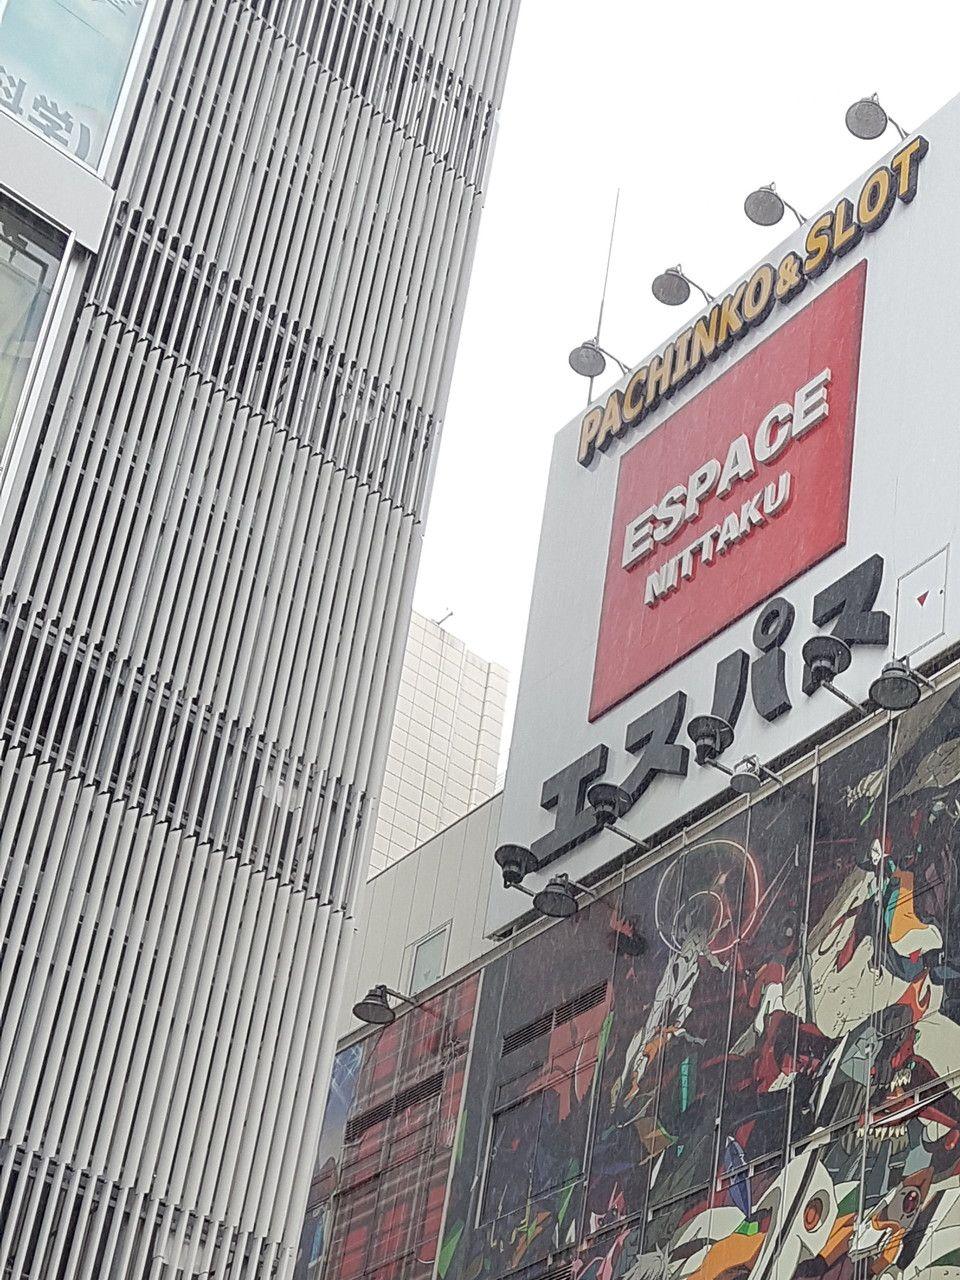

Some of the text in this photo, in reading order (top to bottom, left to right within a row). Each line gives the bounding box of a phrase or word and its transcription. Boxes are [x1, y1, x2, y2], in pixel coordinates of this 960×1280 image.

[622, 367, 832, 572] ESPACE
[644, 470, 793, 607] NITTAKU
[529, 553, 891, 855] エスパス
